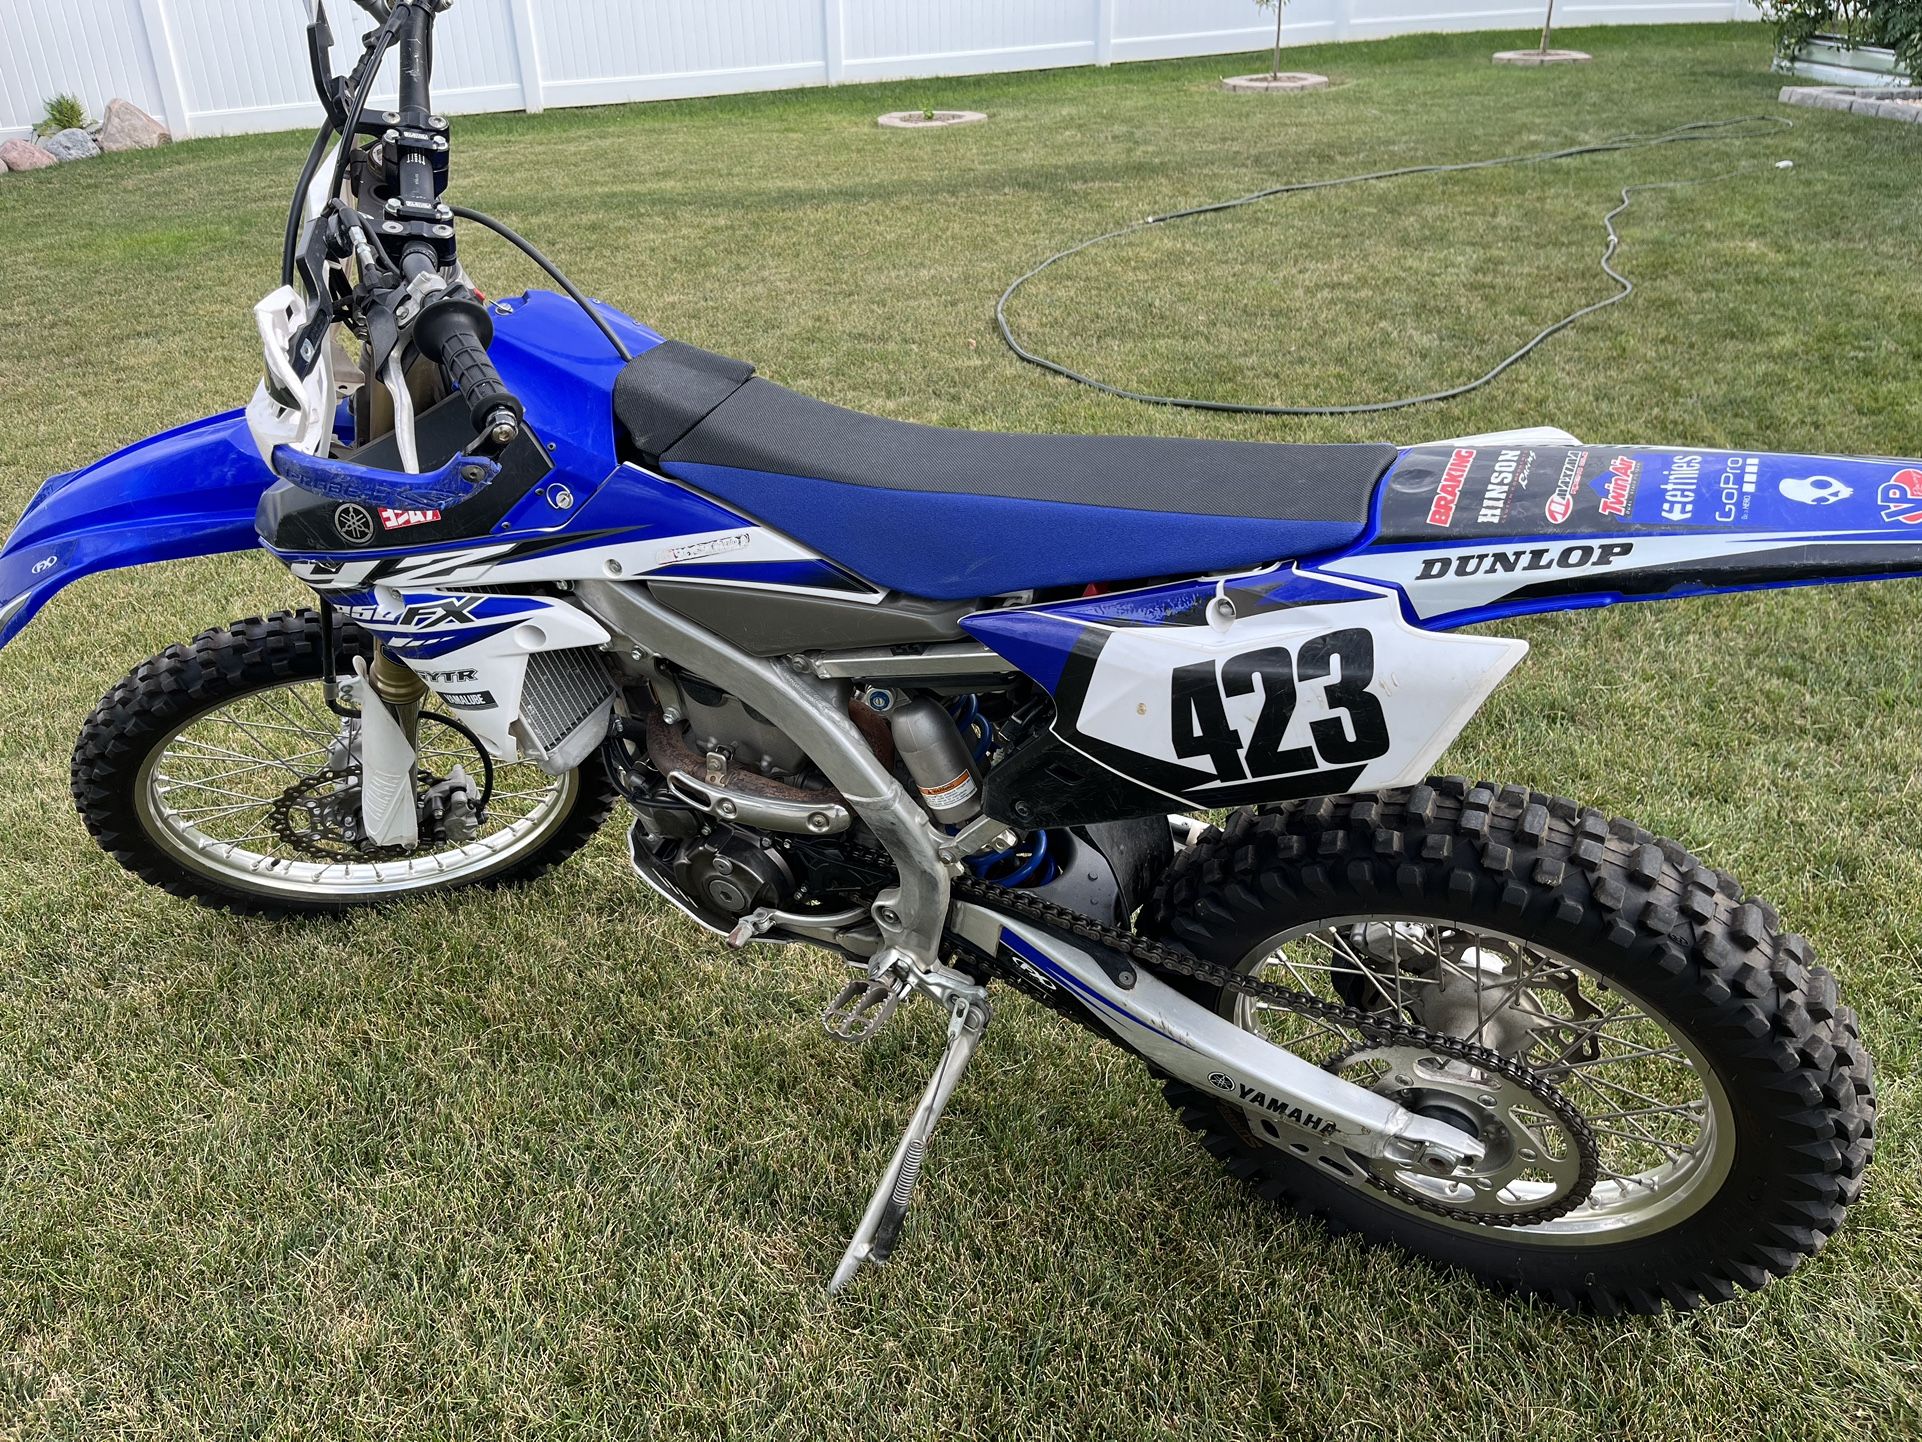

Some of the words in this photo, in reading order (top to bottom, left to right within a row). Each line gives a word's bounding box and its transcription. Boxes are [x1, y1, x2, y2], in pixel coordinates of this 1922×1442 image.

[1426, 448, 1477, 527] BRAKING
[1477, 449, 1521, 523] HINSON
[1660, 455, 1702, 502] etnies
[1715, 457, 1742, 522] GoPro
[1878, 481, 1922, 522] VP
[1414, 543, 1634, 581] DUNLOP
[1171, 628, 1391, 783] 423
[1239, 1083, 1337, 1137] YAMAHA
